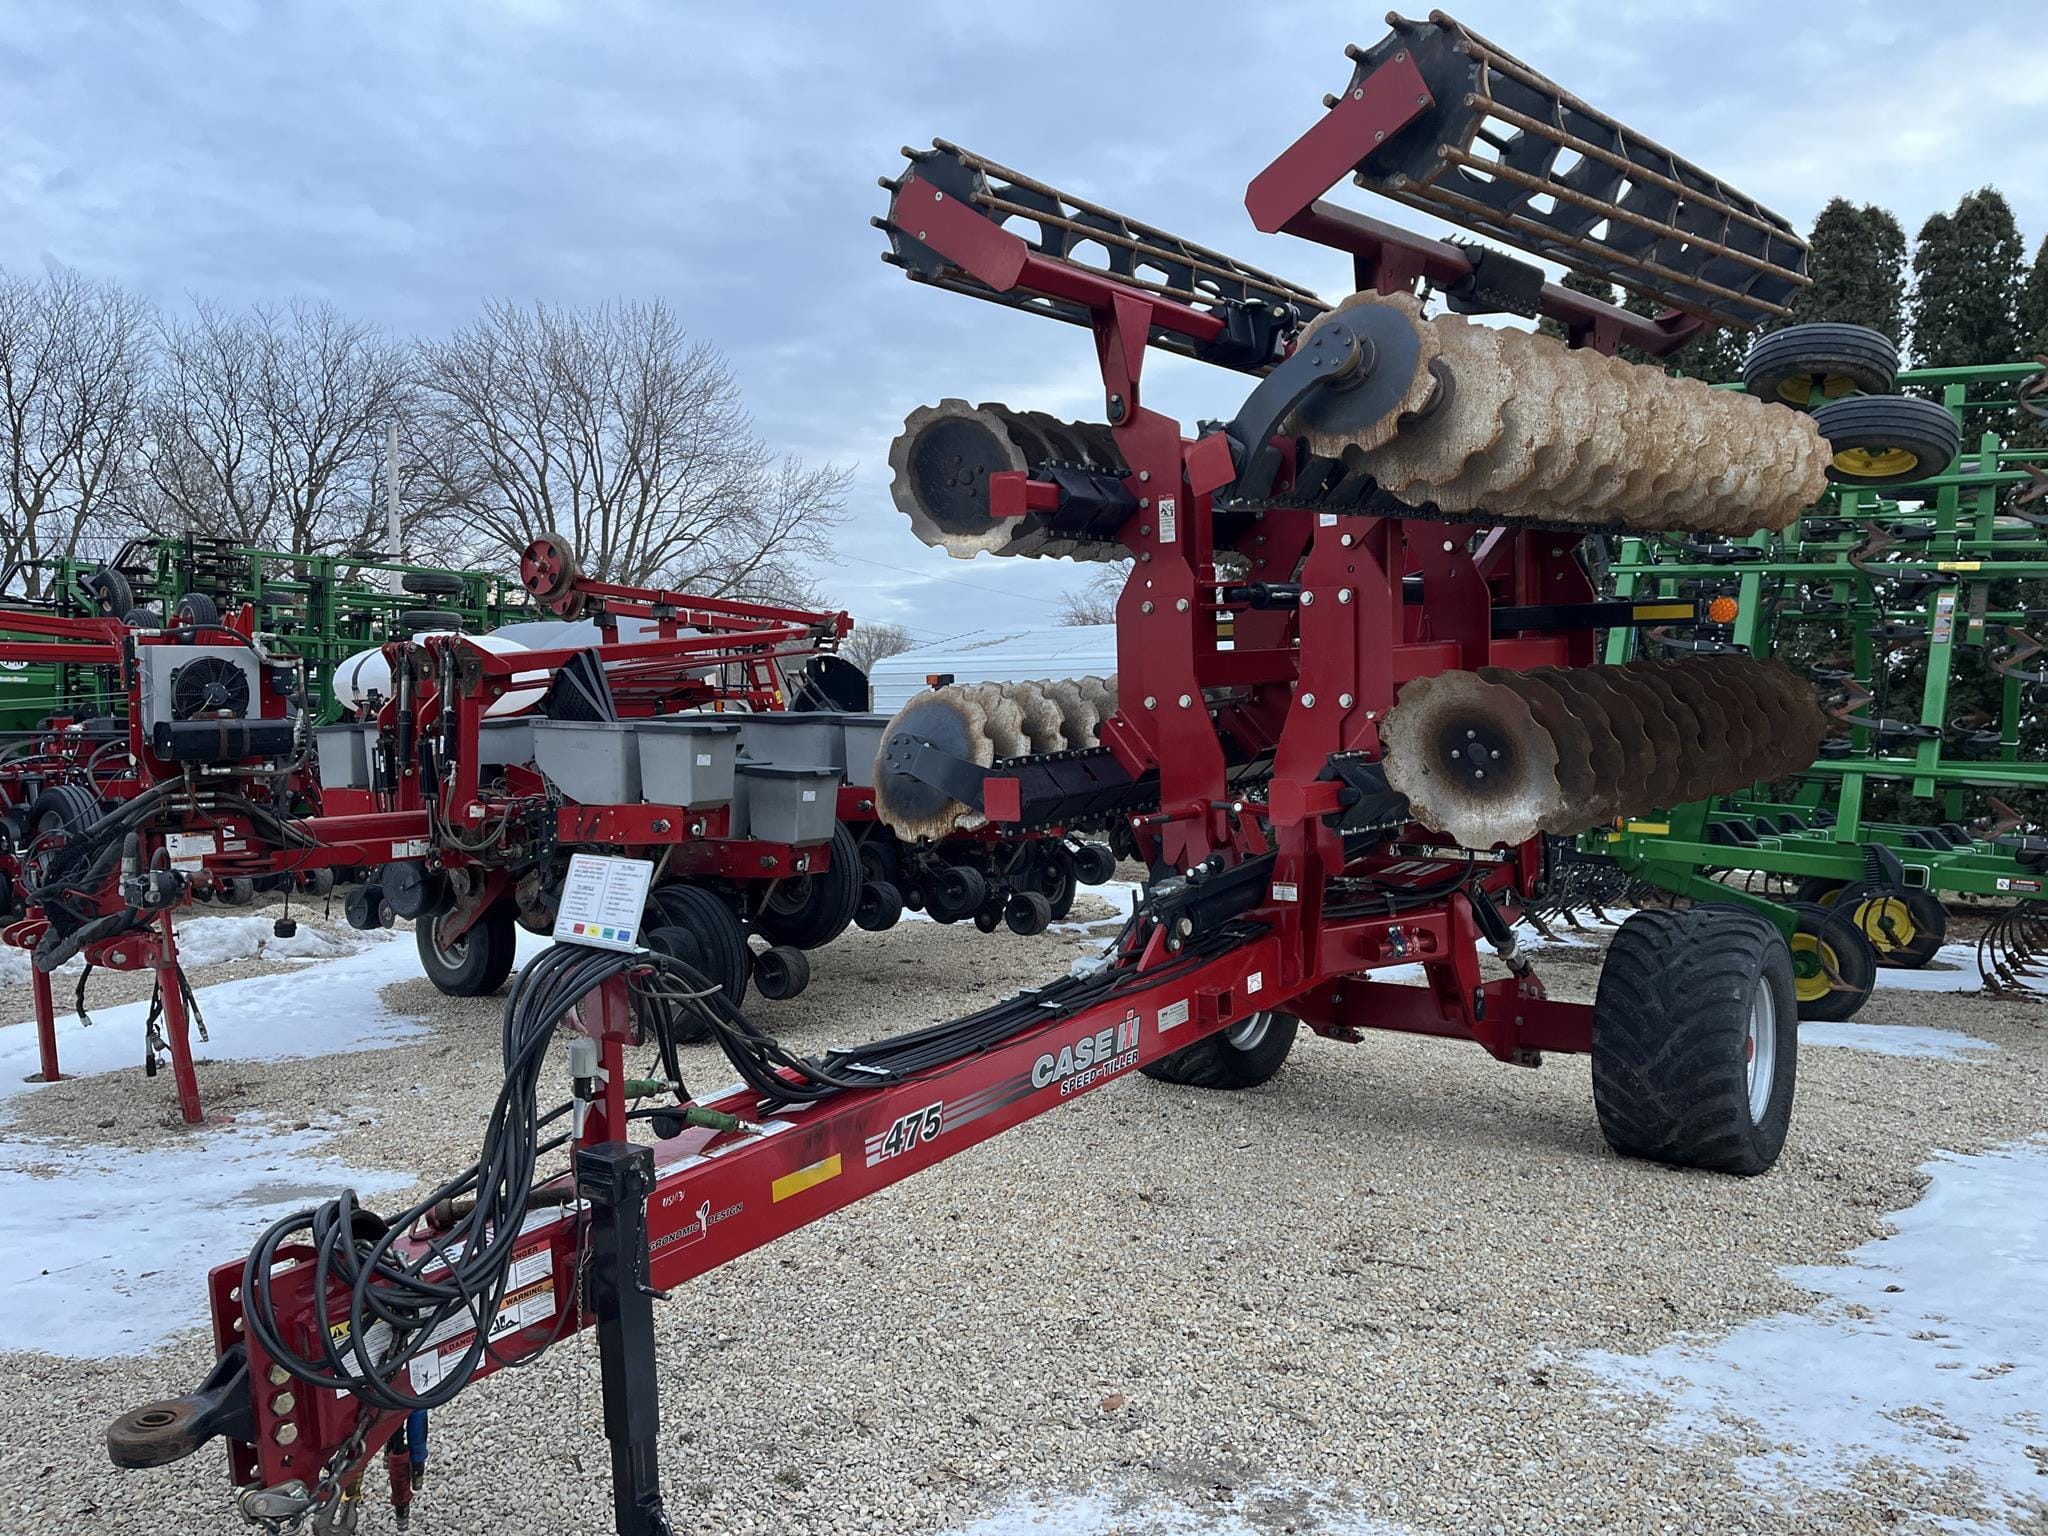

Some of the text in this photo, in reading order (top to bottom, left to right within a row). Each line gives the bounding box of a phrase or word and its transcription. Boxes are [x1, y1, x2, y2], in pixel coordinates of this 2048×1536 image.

[1031, 1027, 1114, 1089] CASE
[1060, 1048, 1139, 1096] SPEED-TILLER
[881, 1100, 944, 1158] 475
[648, 1202, 744, 1252] GRONOMIC DESIGN
[511, 1245, 539, 1261] ANGER
[505, 1285, 544, 1306] WARNING
[448, 1333, 477, 1352] DANGE
